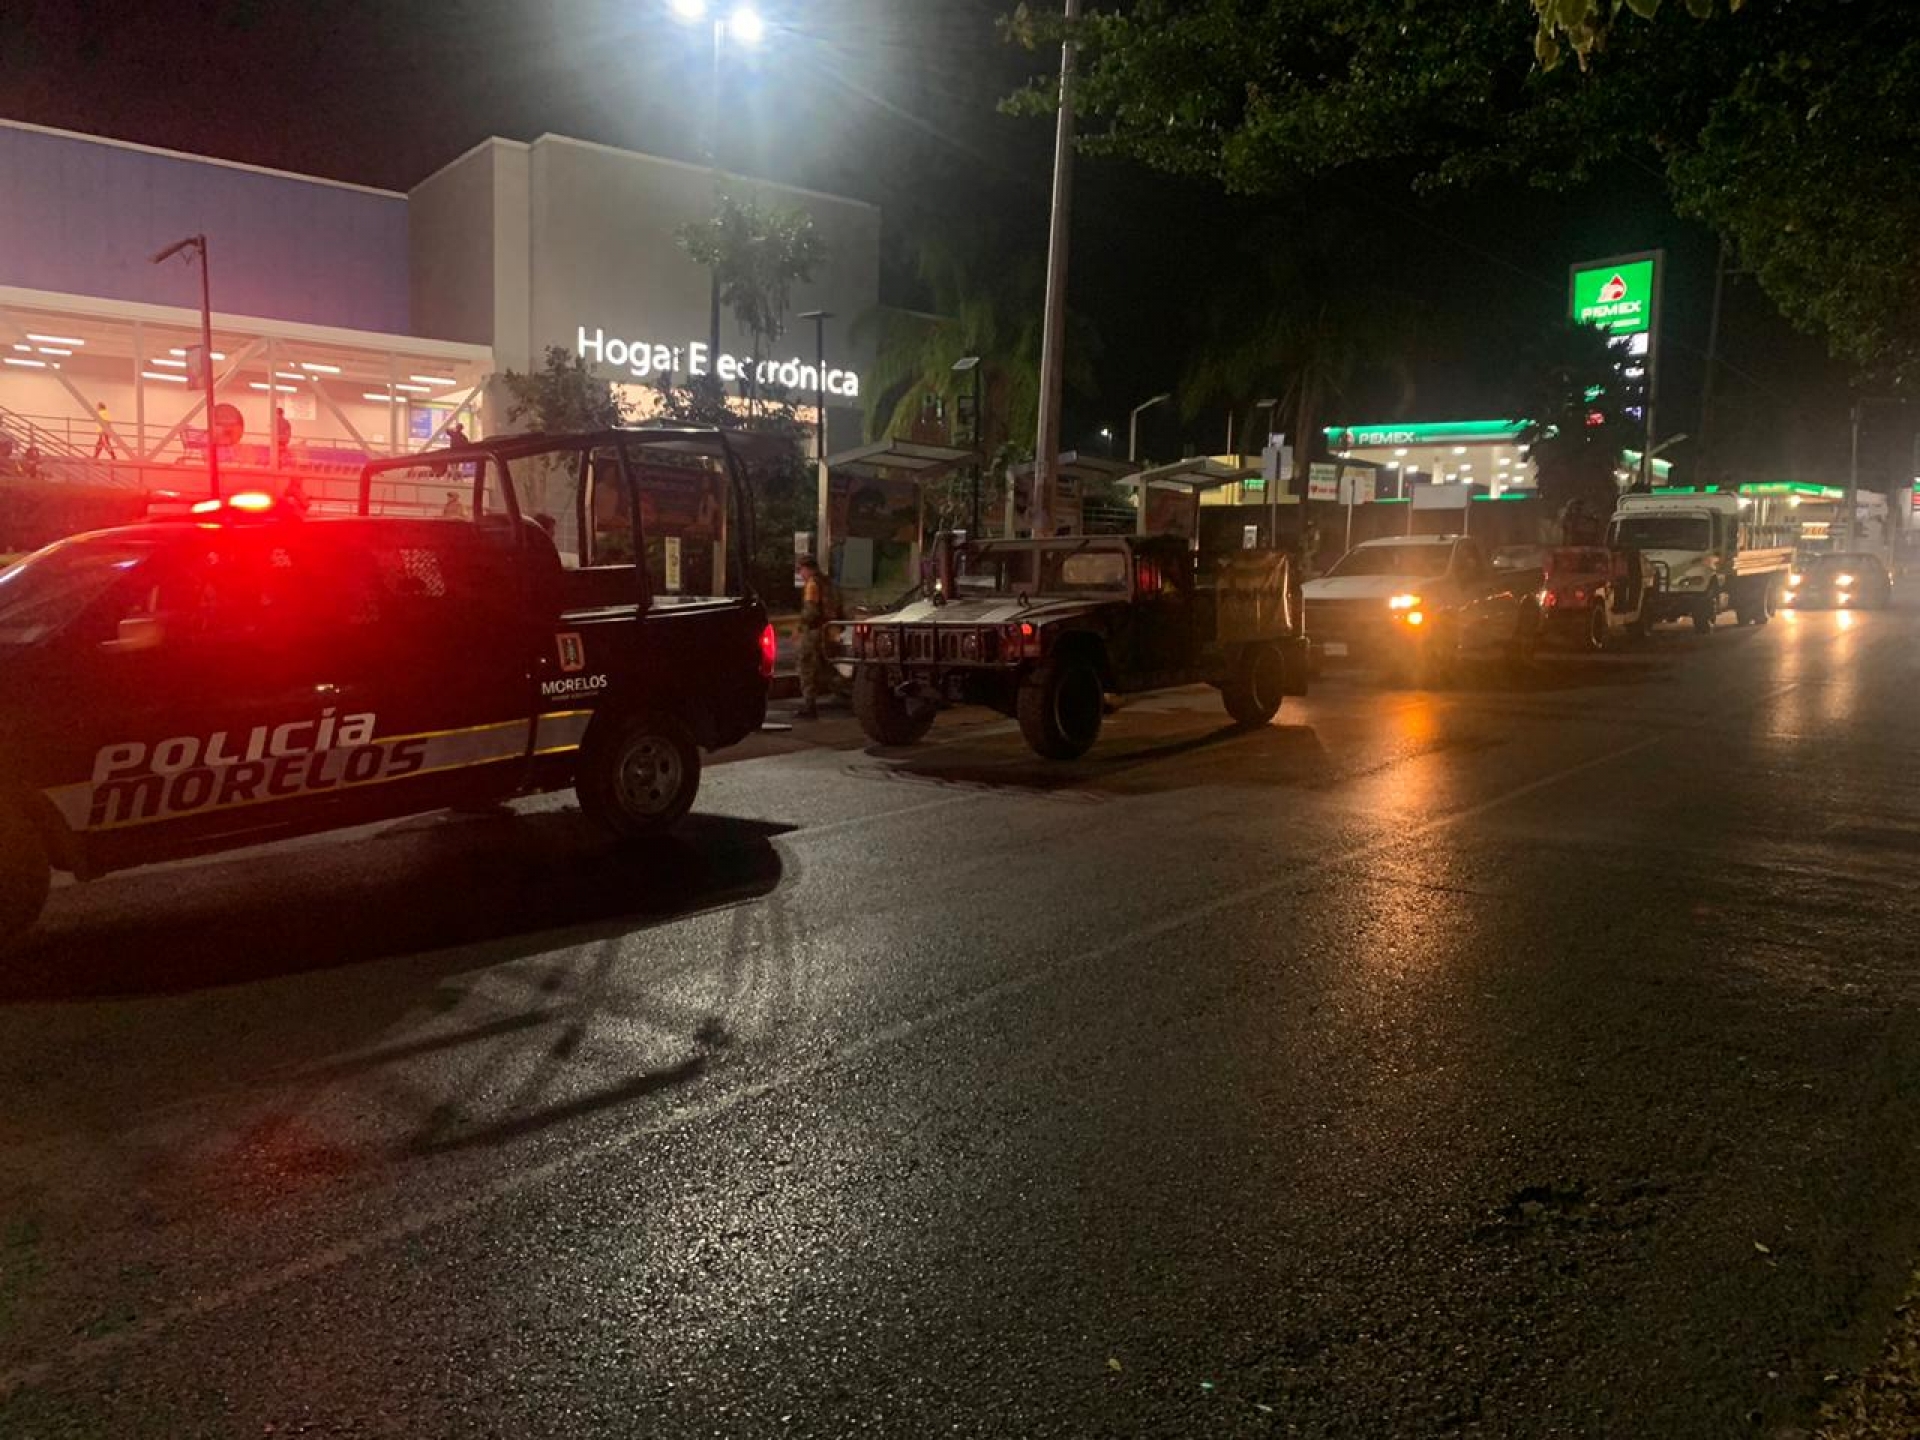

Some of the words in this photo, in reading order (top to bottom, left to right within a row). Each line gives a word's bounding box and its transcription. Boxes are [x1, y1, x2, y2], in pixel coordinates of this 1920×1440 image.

[1582, 301, 1642, 319] PEMEX
[577, 326, 684, 376] Hogar
[1359, 430, 1416, 445] PEMEX
[541, 674, 608, 696] MORELOS
[90, 738, 428, 827] MORELOS
